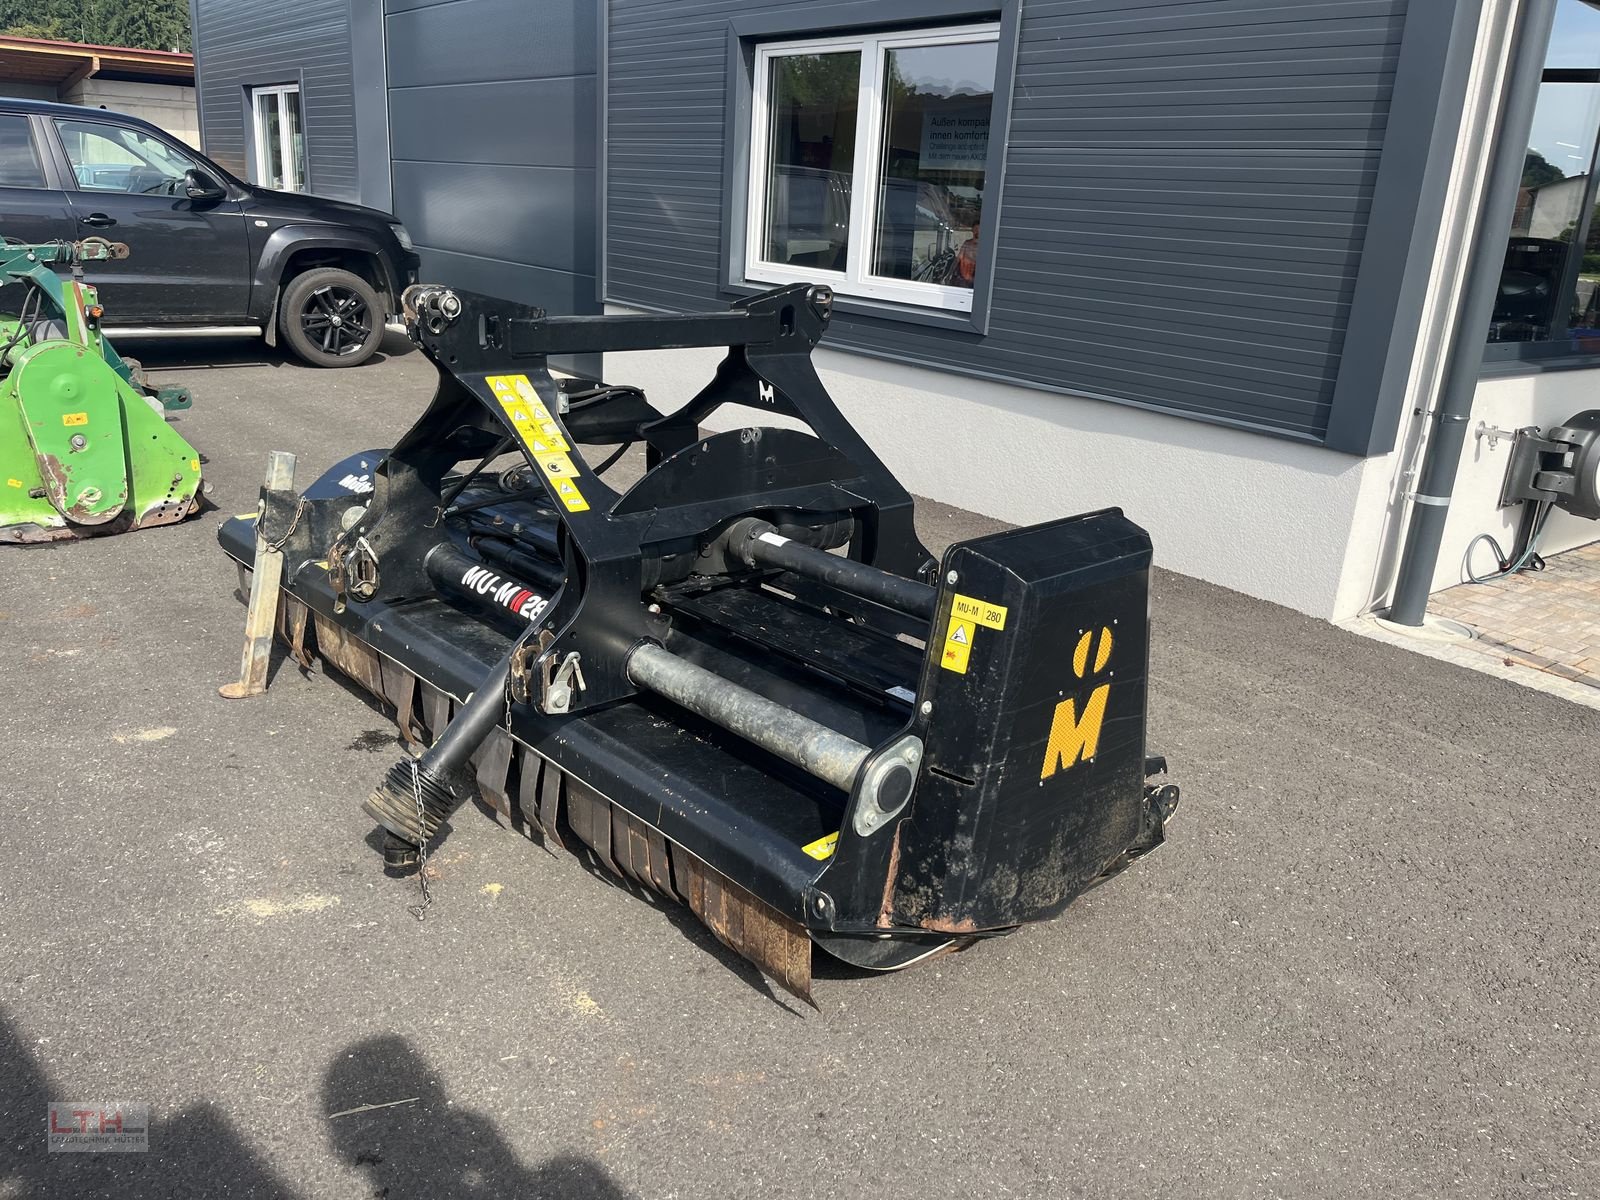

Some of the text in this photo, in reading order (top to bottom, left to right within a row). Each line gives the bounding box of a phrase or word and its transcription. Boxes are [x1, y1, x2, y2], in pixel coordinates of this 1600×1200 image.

[930, 117, 955, 127] Außen
[929, 131, 952, 140] innen
[956, 602, 1002, 623] MU-M 280
